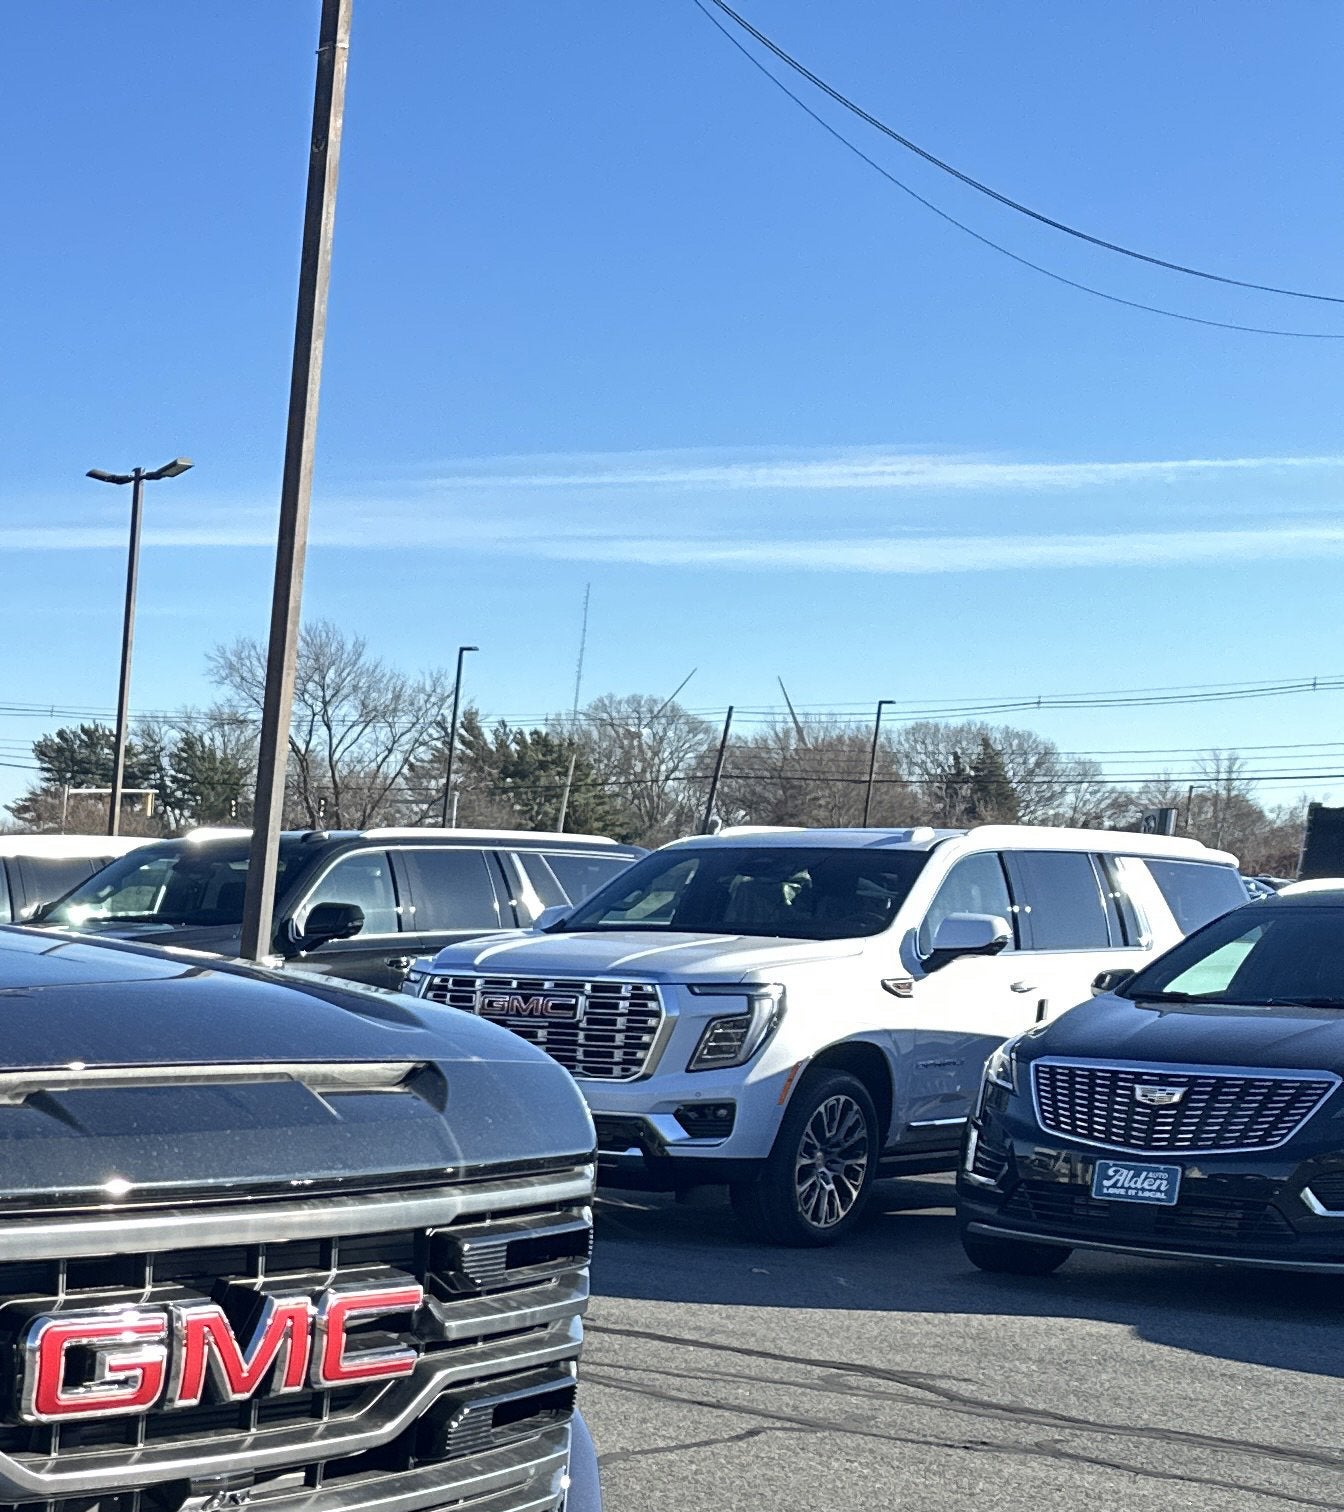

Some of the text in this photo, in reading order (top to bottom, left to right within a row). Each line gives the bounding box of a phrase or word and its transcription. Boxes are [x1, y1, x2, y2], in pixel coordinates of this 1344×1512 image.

[480, 994, 576, 1017] GMC
[1102, 1166, 1170, 1191] Alden
[1147, 1172, 1169, 1180] AUTO
[1103, 1187, 1127, 1195] LOVE
[1137, 1190, 1167, 1199] LOCAL
[23, 1285, 424, 1424] GMC
